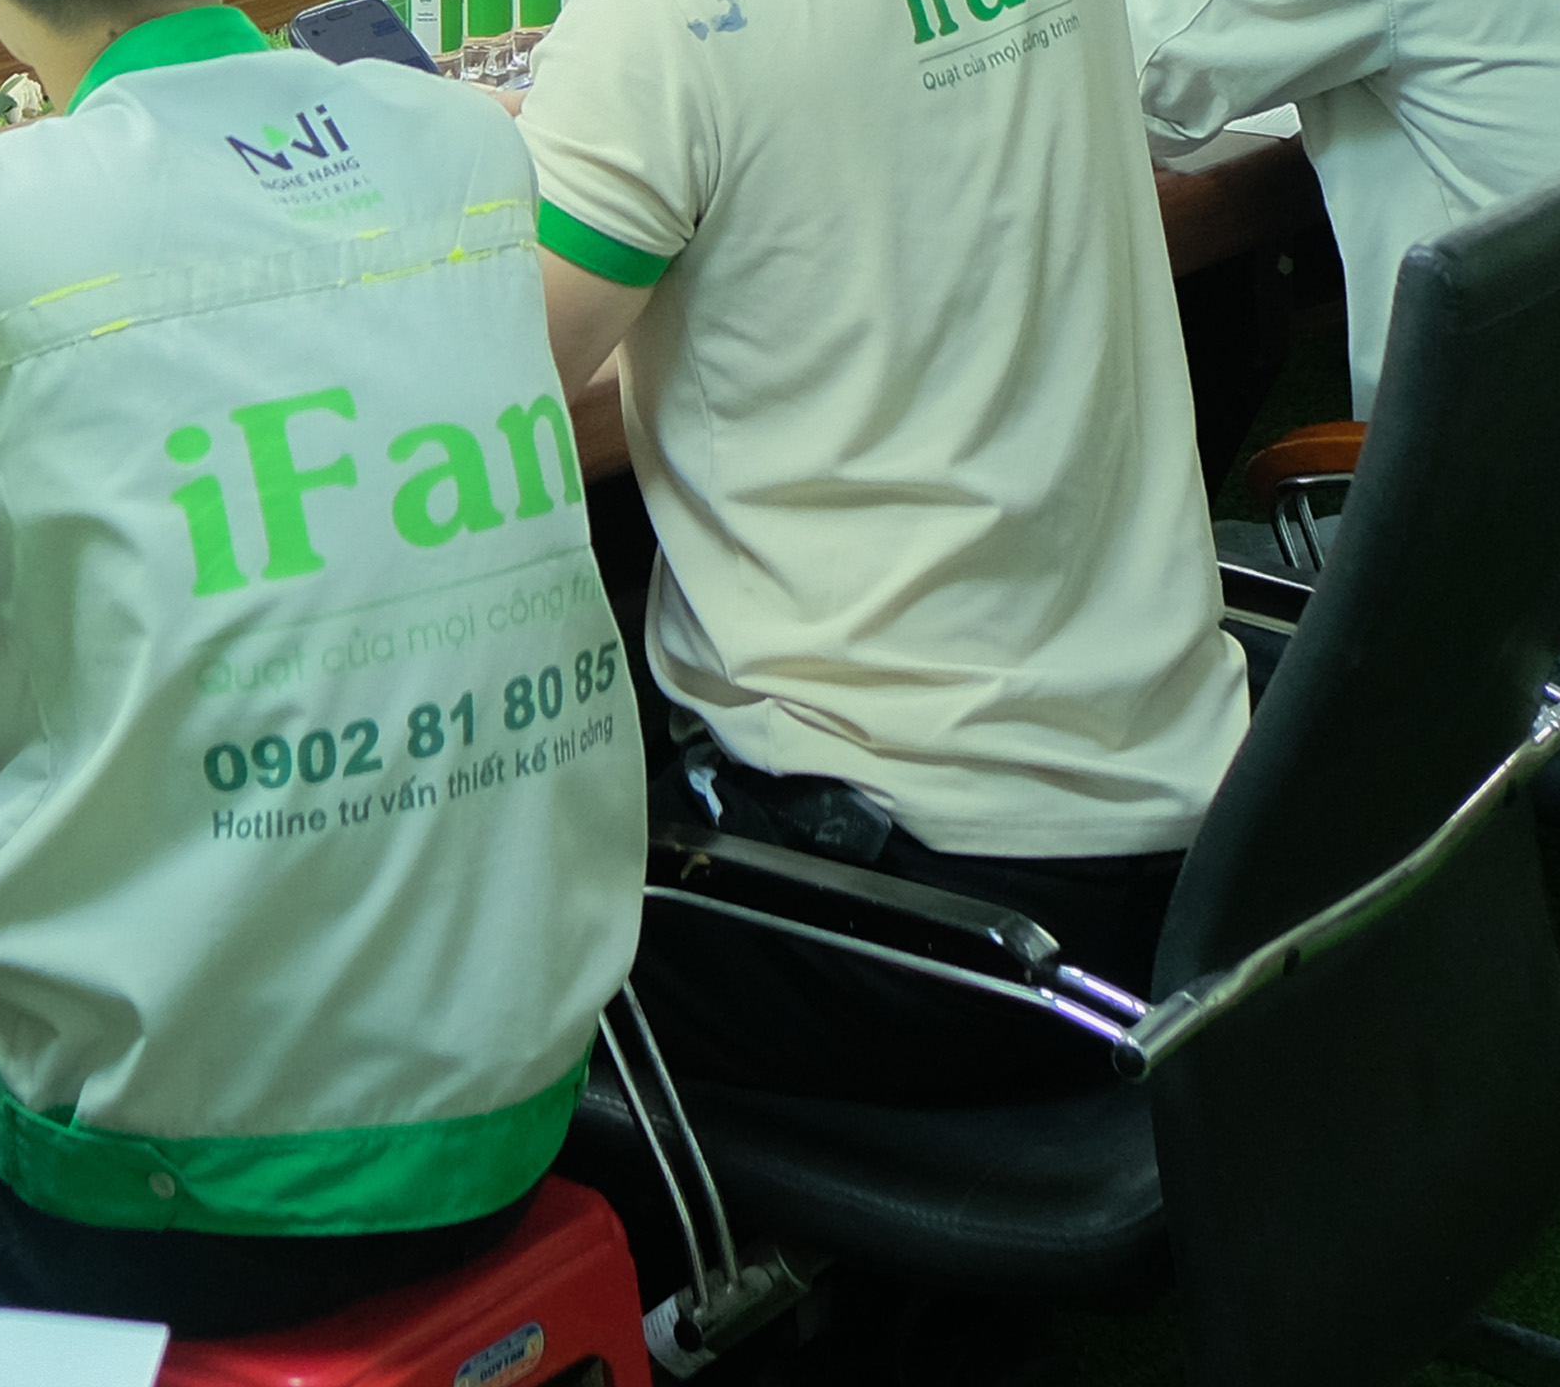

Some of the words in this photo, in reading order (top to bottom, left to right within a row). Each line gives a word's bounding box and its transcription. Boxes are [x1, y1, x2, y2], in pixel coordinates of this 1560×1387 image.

[164, 386, 582, 598] iFan
[202, 717, 383, 793] 0902
[406, 689, 477, 759] 81
[503, 664, 565, 732] 80
[574, 639, 618, 705] 85
[211, 807, 328, 840] Hotline
[338, 793, 373, 828] tư
[380, 773, 438, 811] vấn
[448, 750, 507, 801] thiết
[514, 737, 548, 779] kế
